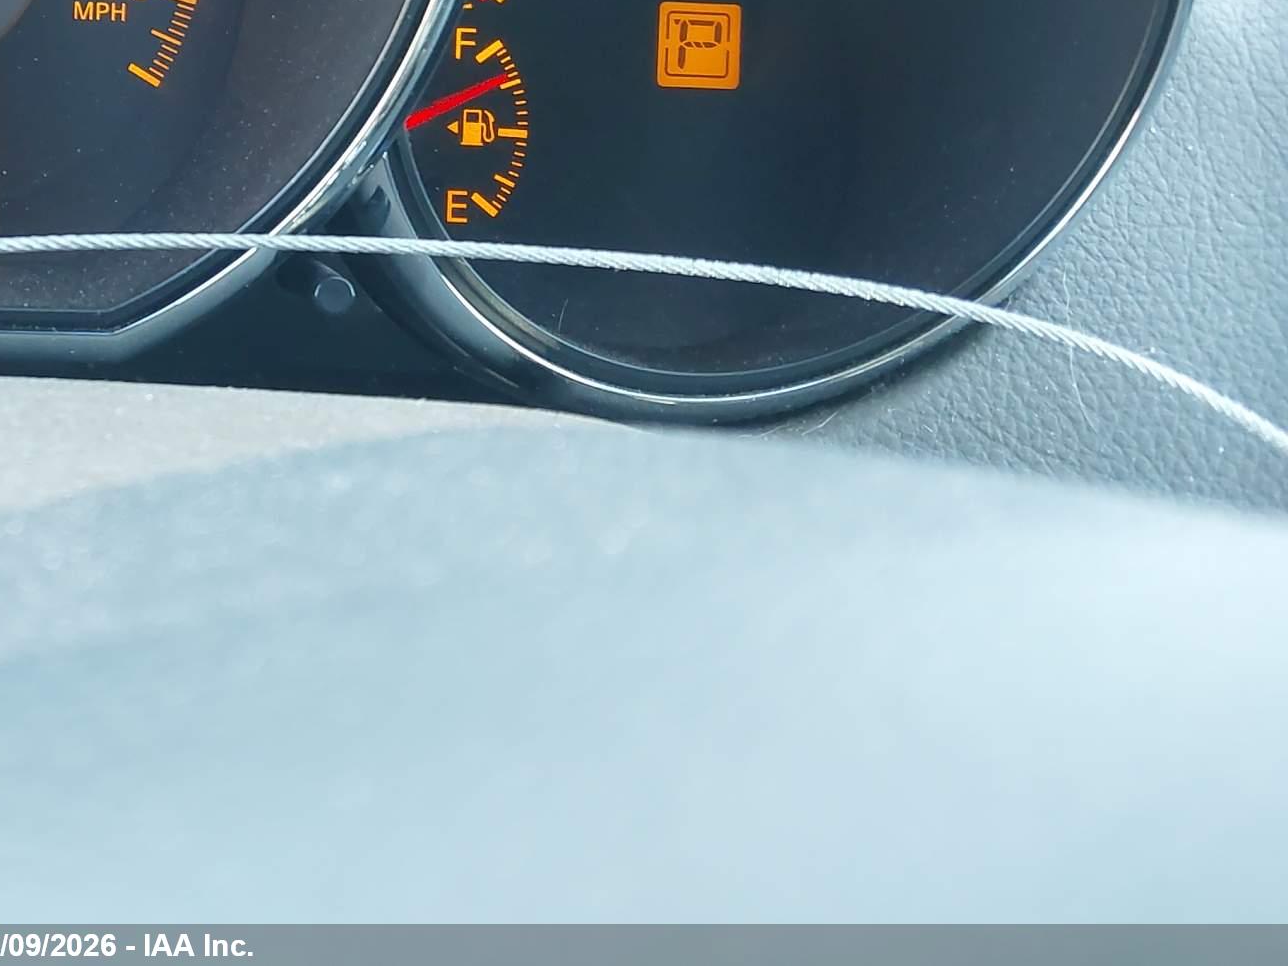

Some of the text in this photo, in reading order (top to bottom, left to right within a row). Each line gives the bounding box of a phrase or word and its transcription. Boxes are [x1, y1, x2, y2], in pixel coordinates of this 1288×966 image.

[73, 0, 126, 22] MPH
[455, 27, 477, 59] F
[673, 19, 722, 70] P
[447, 190, 468, 223] E
